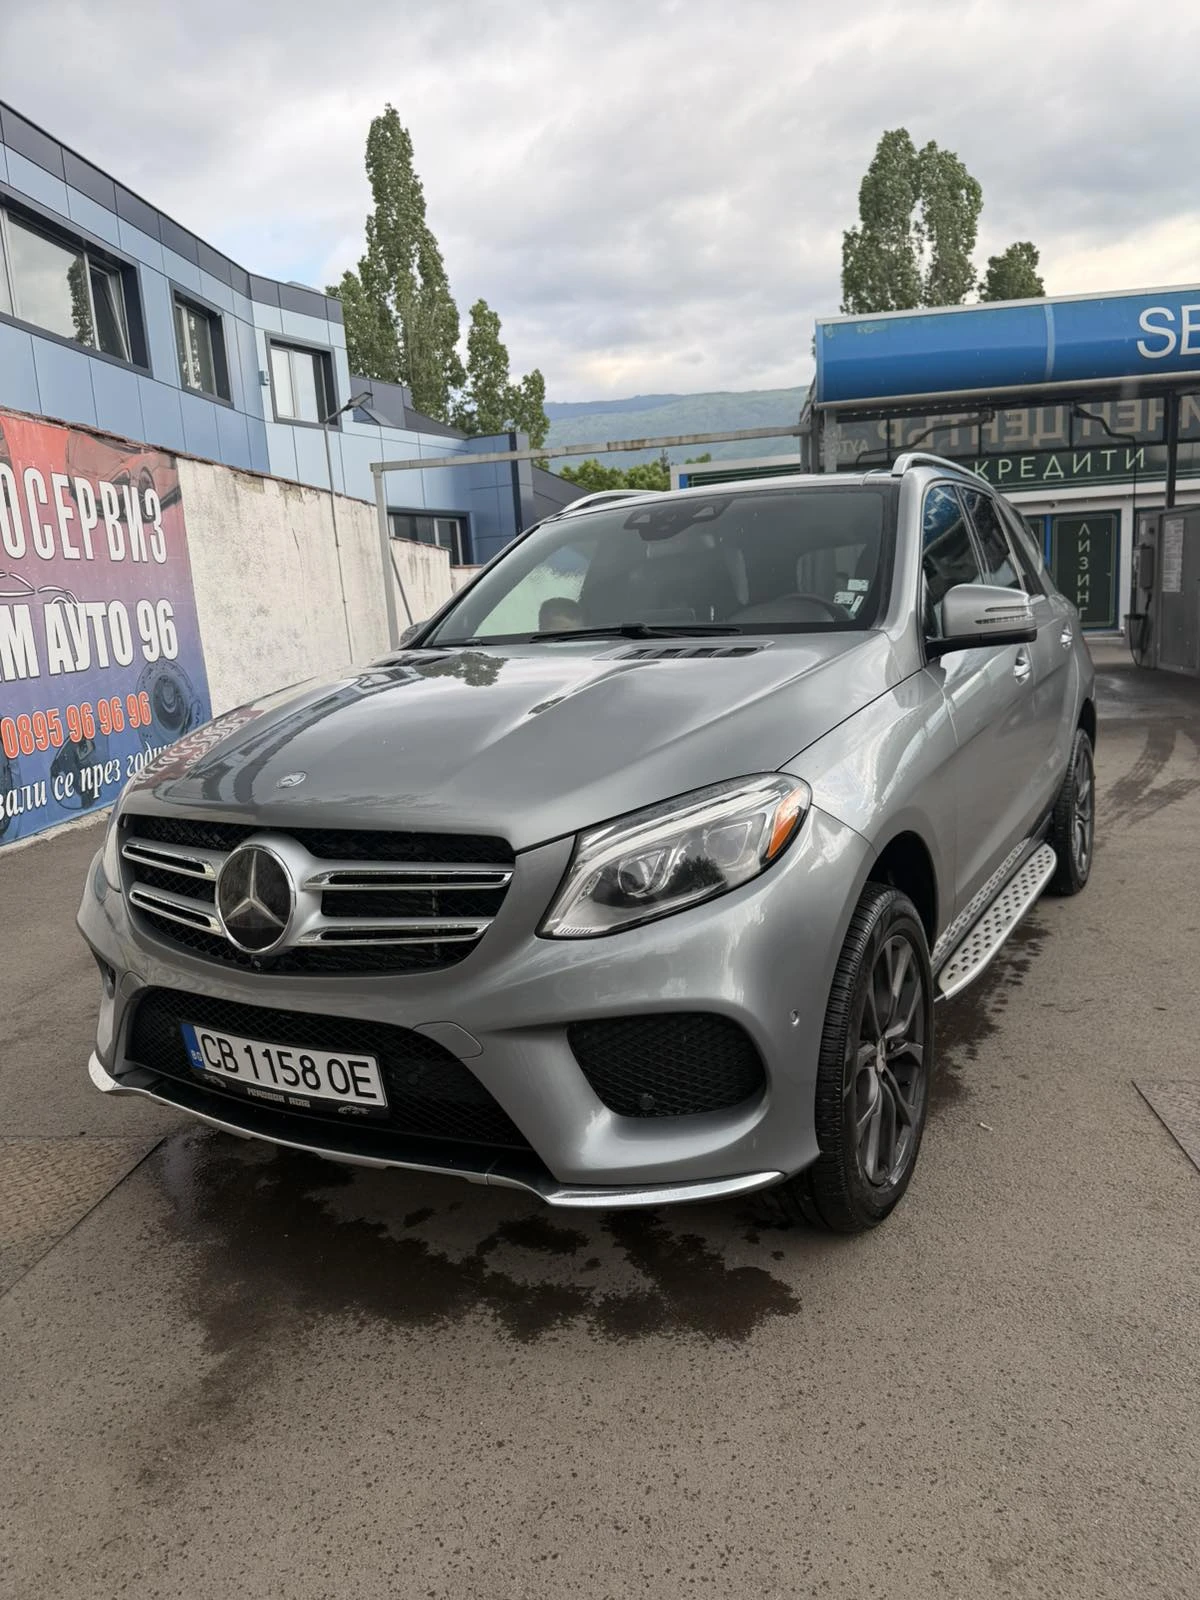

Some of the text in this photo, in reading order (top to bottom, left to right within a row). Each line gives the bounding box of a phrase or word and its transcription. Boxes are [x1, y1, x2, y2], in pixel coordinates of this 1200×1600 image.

[1137, 305, 1200, 358] SE
[974, 448, 1144, 480] КРЕДИТИ
[0, 462, 167, 564] ОСЕРВИЗ
[1077, 523, 1091, 619] ЛИЗИНГ
[0, 599, 178, 682] М АУТО 96
[1, 691, 152, 759] 0895 96 96 96
[54, 771, 75, 801] се
[80, 758, 121, 799] през
[201, 1034, 239, 1073] CB
[244, 1045, 321, 1090] 1158
[327, 1059, 377, 1099] OE
